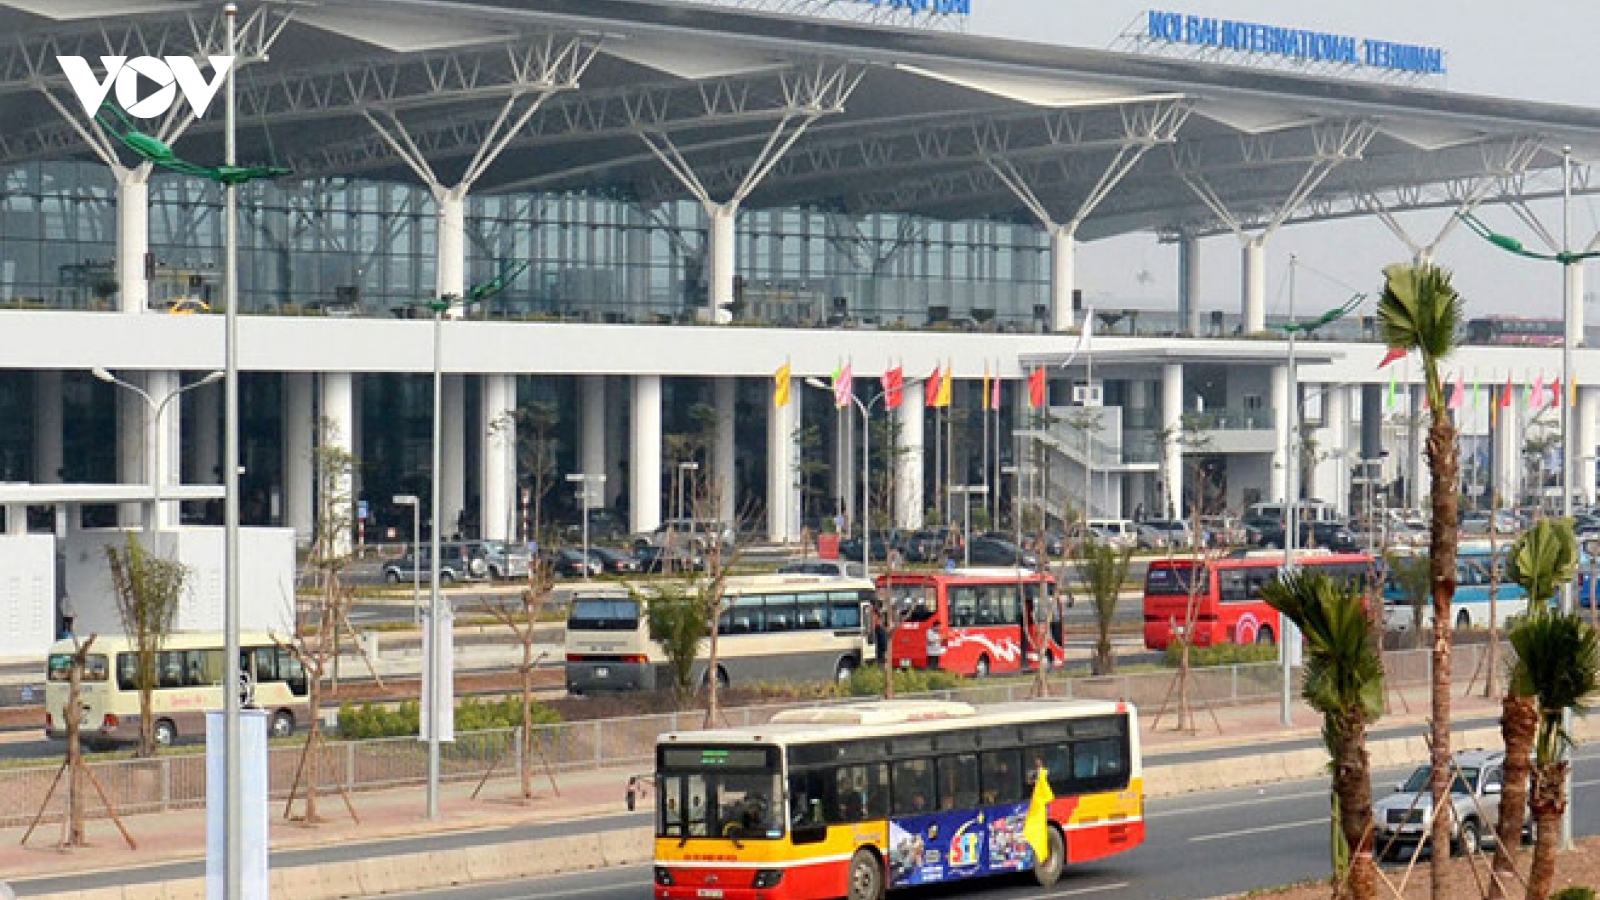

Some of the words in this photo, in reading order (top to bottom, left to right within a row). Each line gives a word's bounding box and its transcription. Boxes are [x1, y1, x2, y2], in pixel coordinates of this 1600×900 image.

[1187, 15, 1217, 46] BAI
[1222, 20, 1359, 64] INTERNATIONAL
[1364, 38, 1446, 74] TERMINAL
